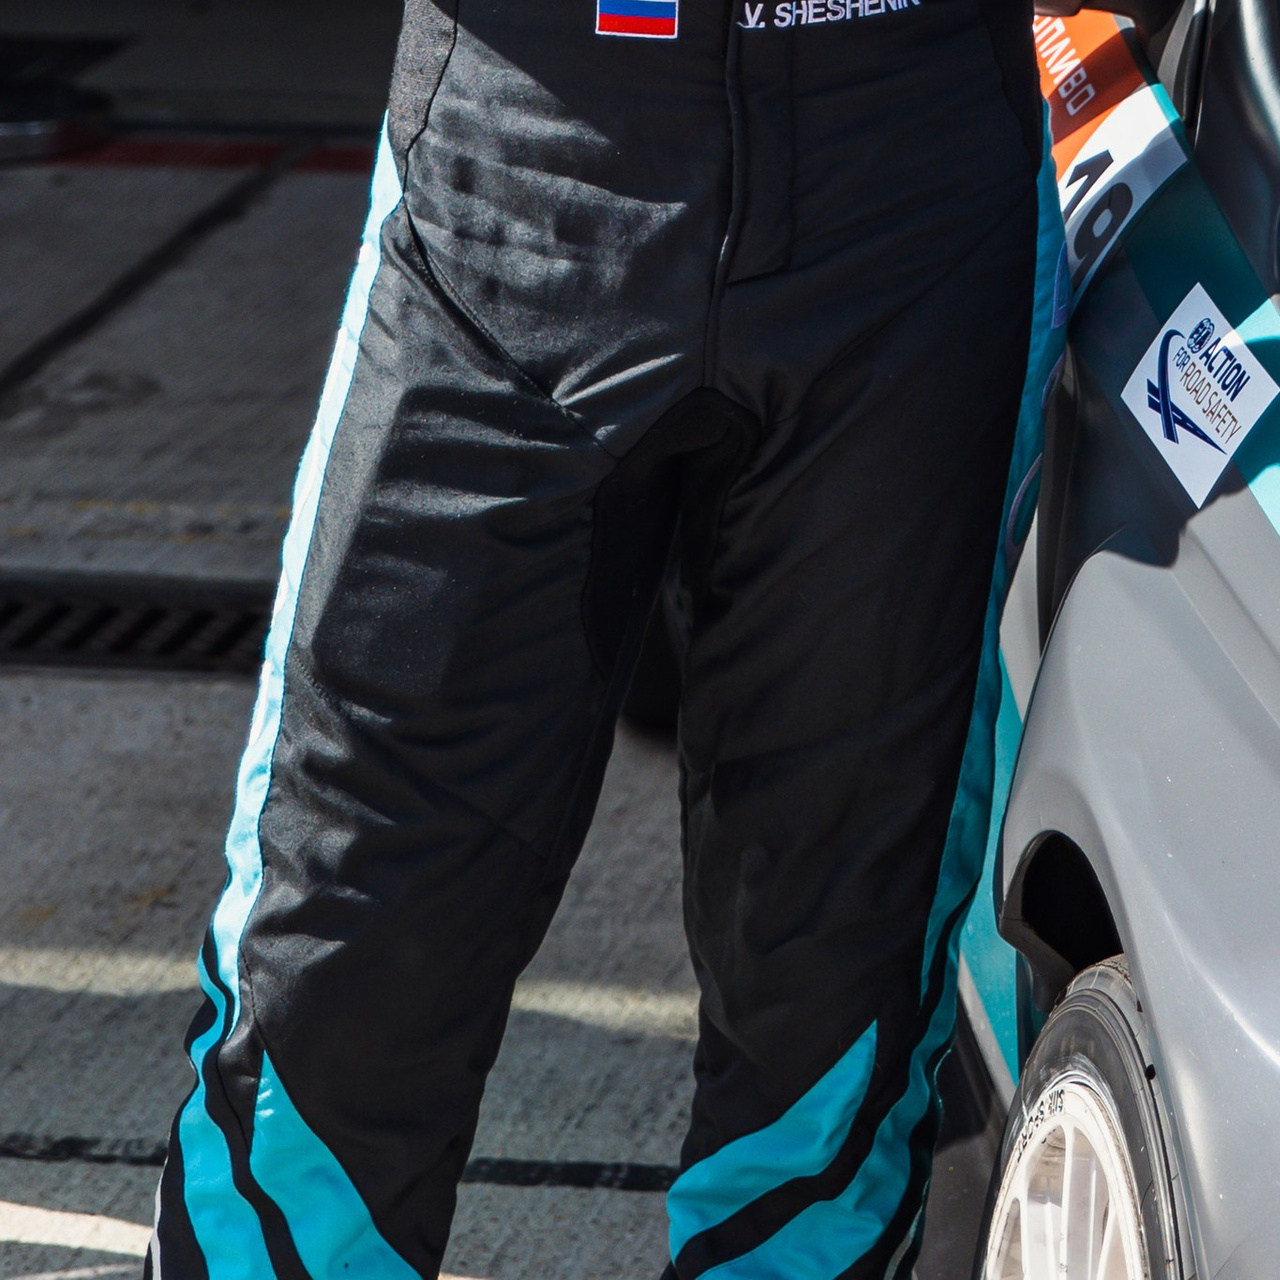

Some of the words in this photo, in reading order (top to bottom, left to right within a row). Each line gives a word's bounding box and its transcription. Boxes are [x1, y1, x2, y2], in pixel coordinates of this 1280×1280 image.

[1063, 149, 1134, 294] 19
[1173, 346, 1192, 373] FOR
[1180, 361, 1212, 406] ROAD
[1199, 336, 1251, 403] ACTION
[1201, 391, 1243, 445] SAFETY
